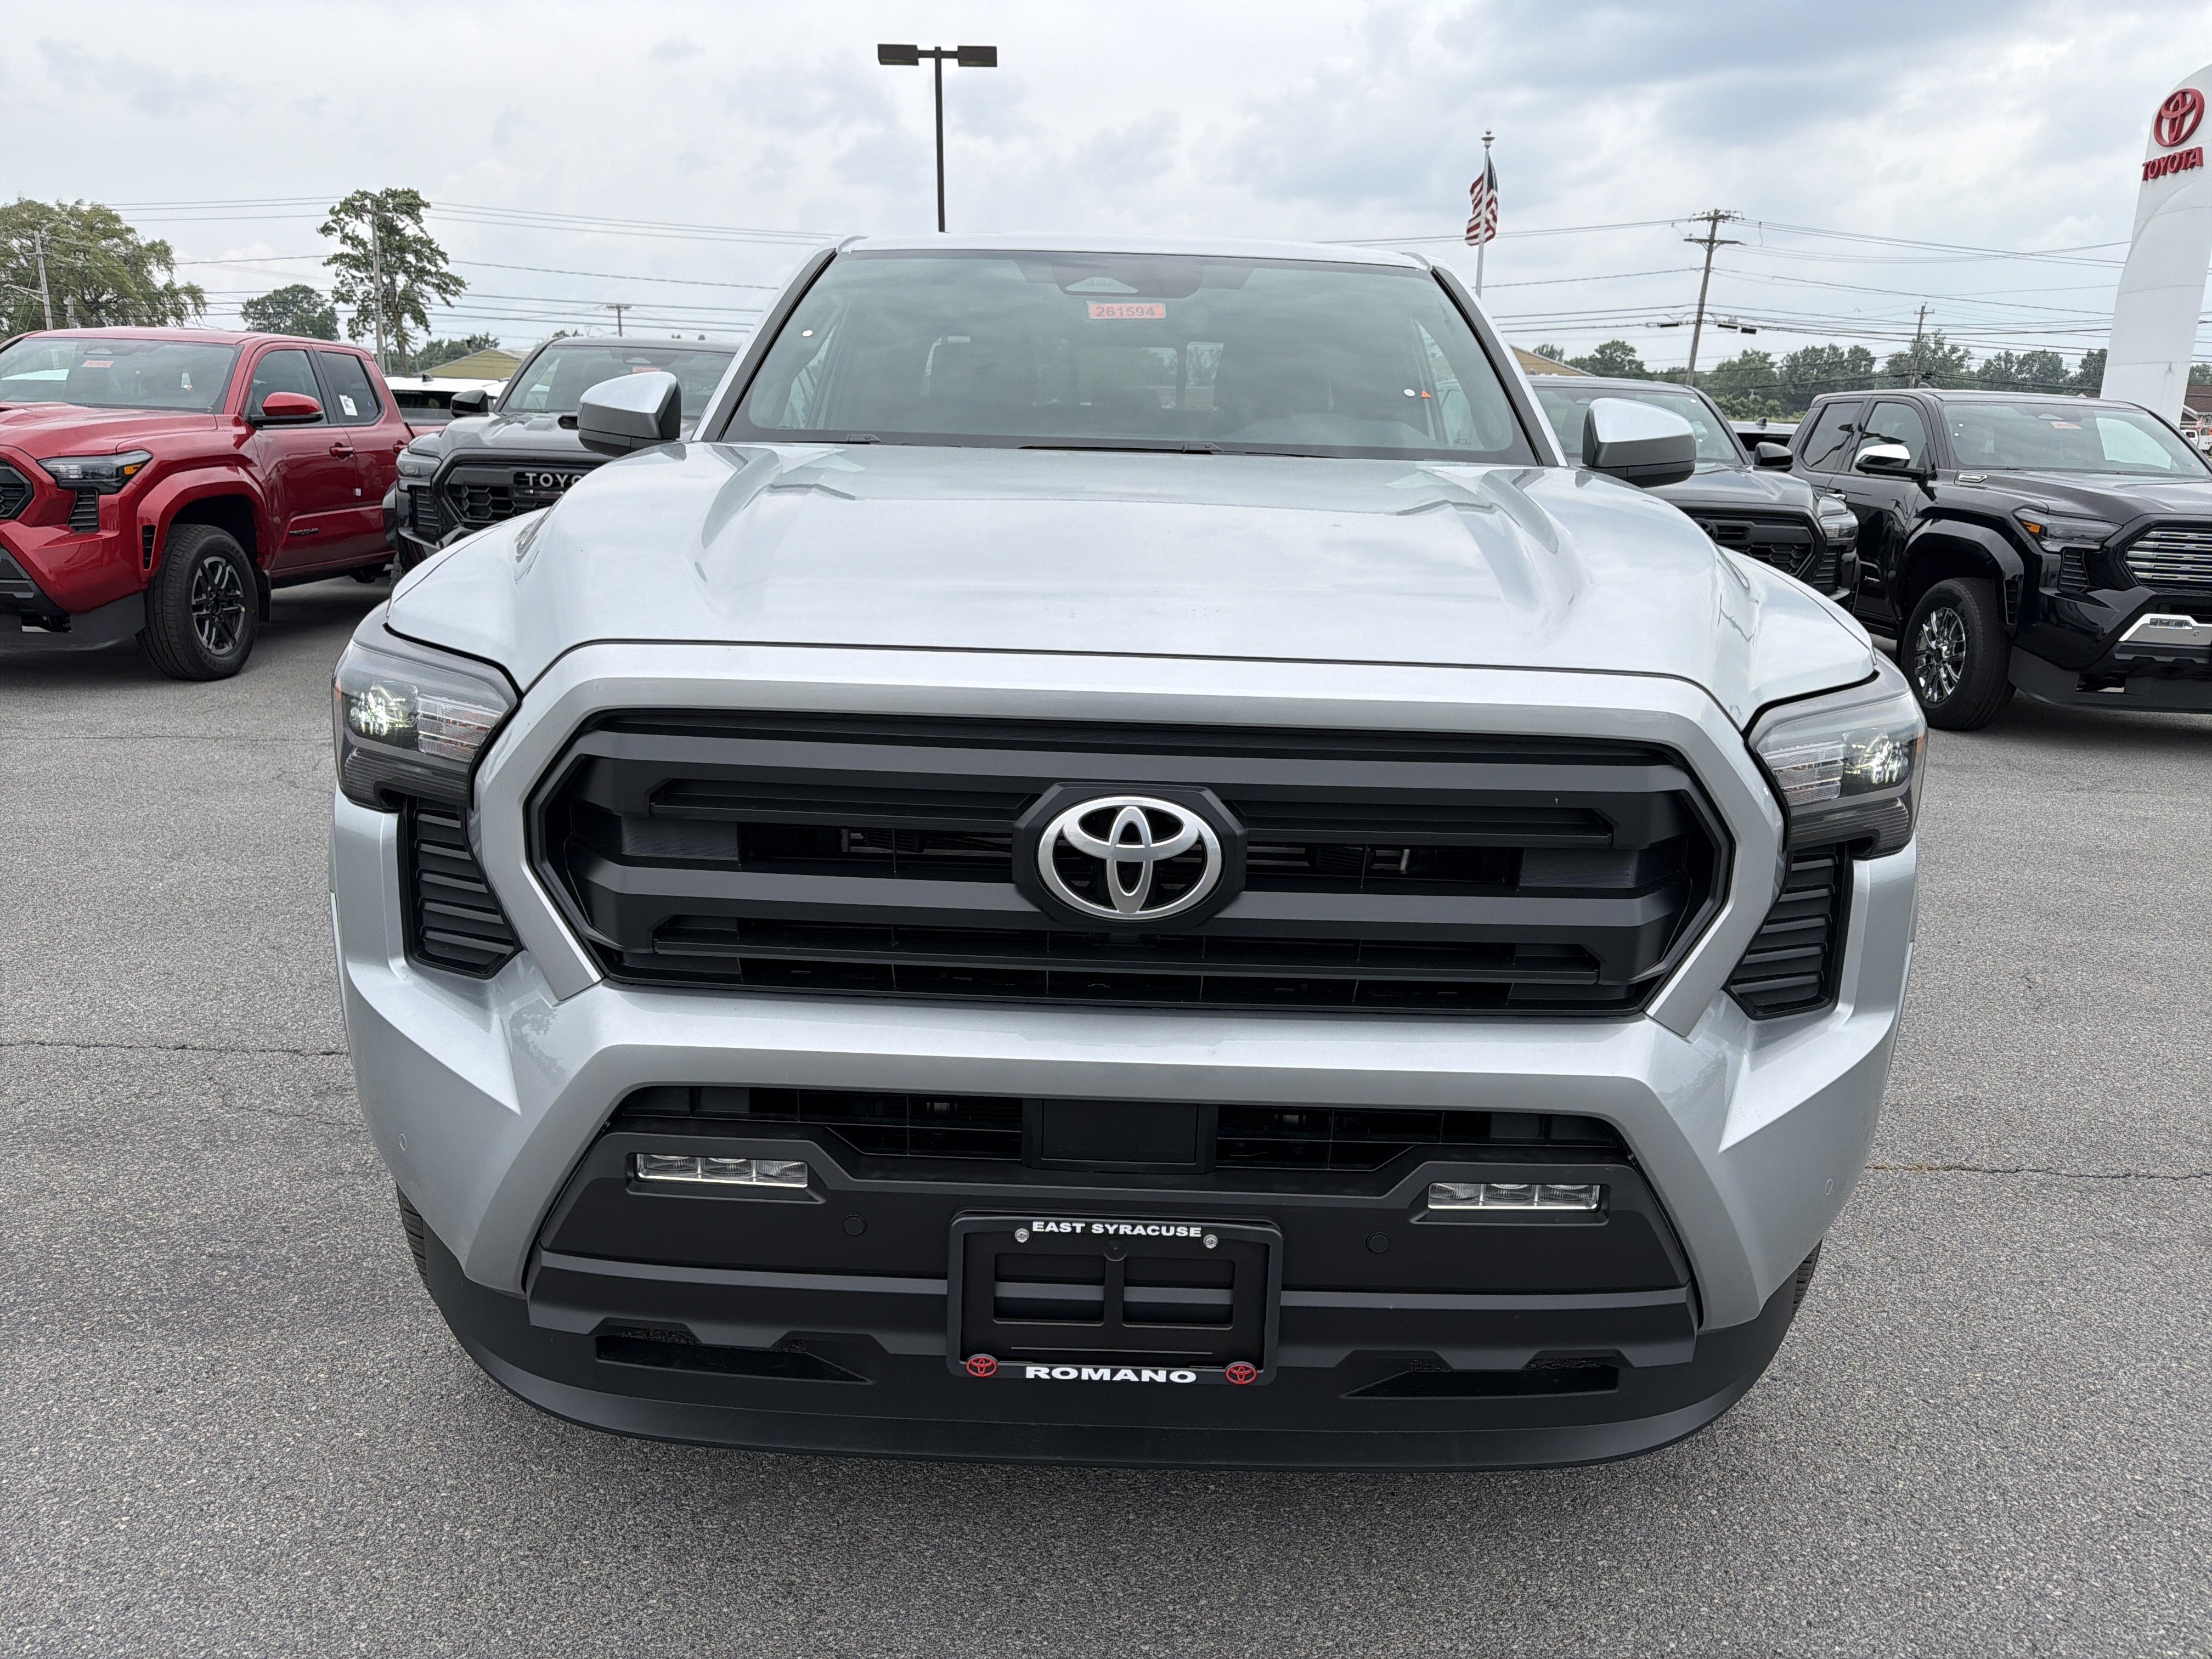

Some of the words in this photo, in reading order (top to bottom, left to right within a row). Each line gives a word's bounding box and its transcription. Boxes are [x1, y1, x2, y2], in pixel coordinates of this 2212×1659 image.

[2142, 146, 2203, 181] TOYOTA
[1096, 307, 1155, 317] 261594
[1032, 1221, 1086, 1233] EAST
[1091, 1223, 1201, 1237] SYRACUSE
[1025, 1366, 1197, 1383] ROMANO
